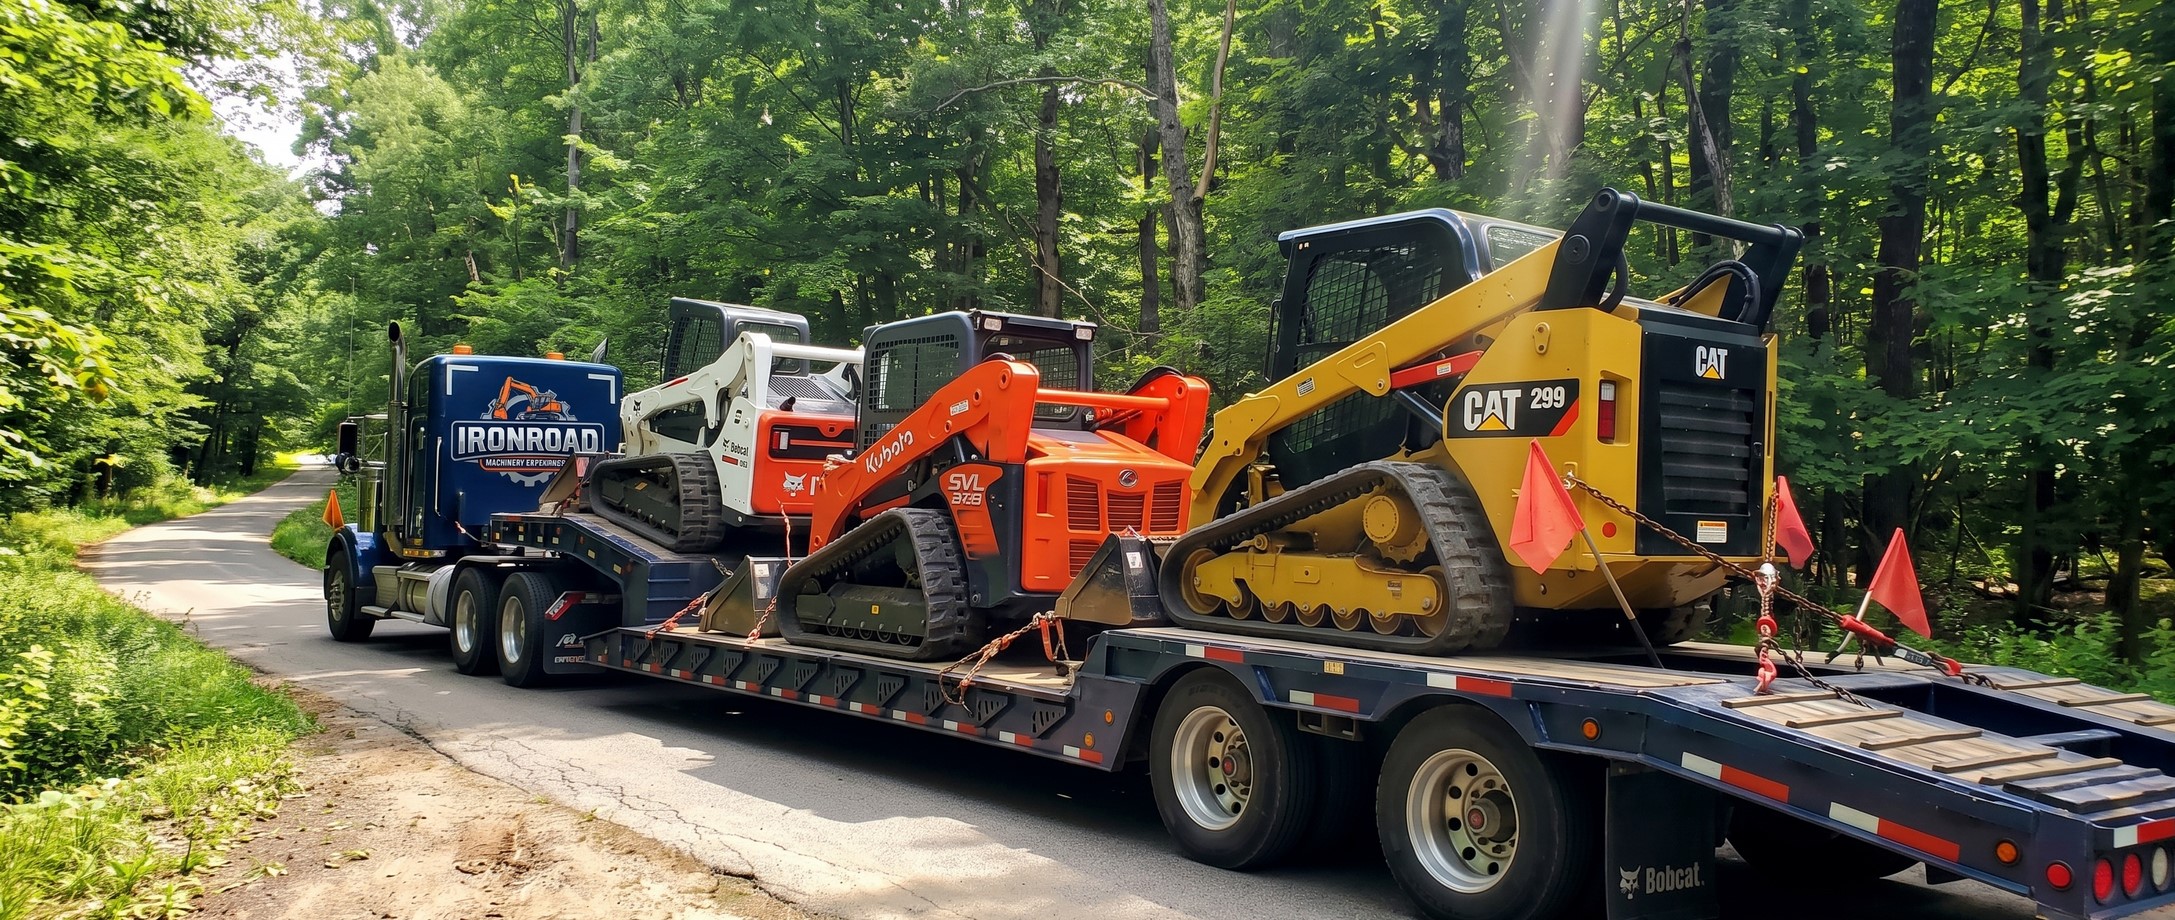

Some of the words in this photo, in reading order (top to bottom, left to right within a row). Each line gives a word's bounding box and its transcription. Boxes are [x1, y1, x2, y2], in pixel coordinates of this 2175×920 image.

[1695, 345, 1728, 380] CAT
[1463, 389, 1522, 431] CAT
[1530, 386, 1565, 409] 299
[458, 426, 599, 454] IRONROAD
[865, 430, 914, 473] Kubota
[485, 458, 525, 467] MACHINERY
[947, 473, 985, 492] SVL
